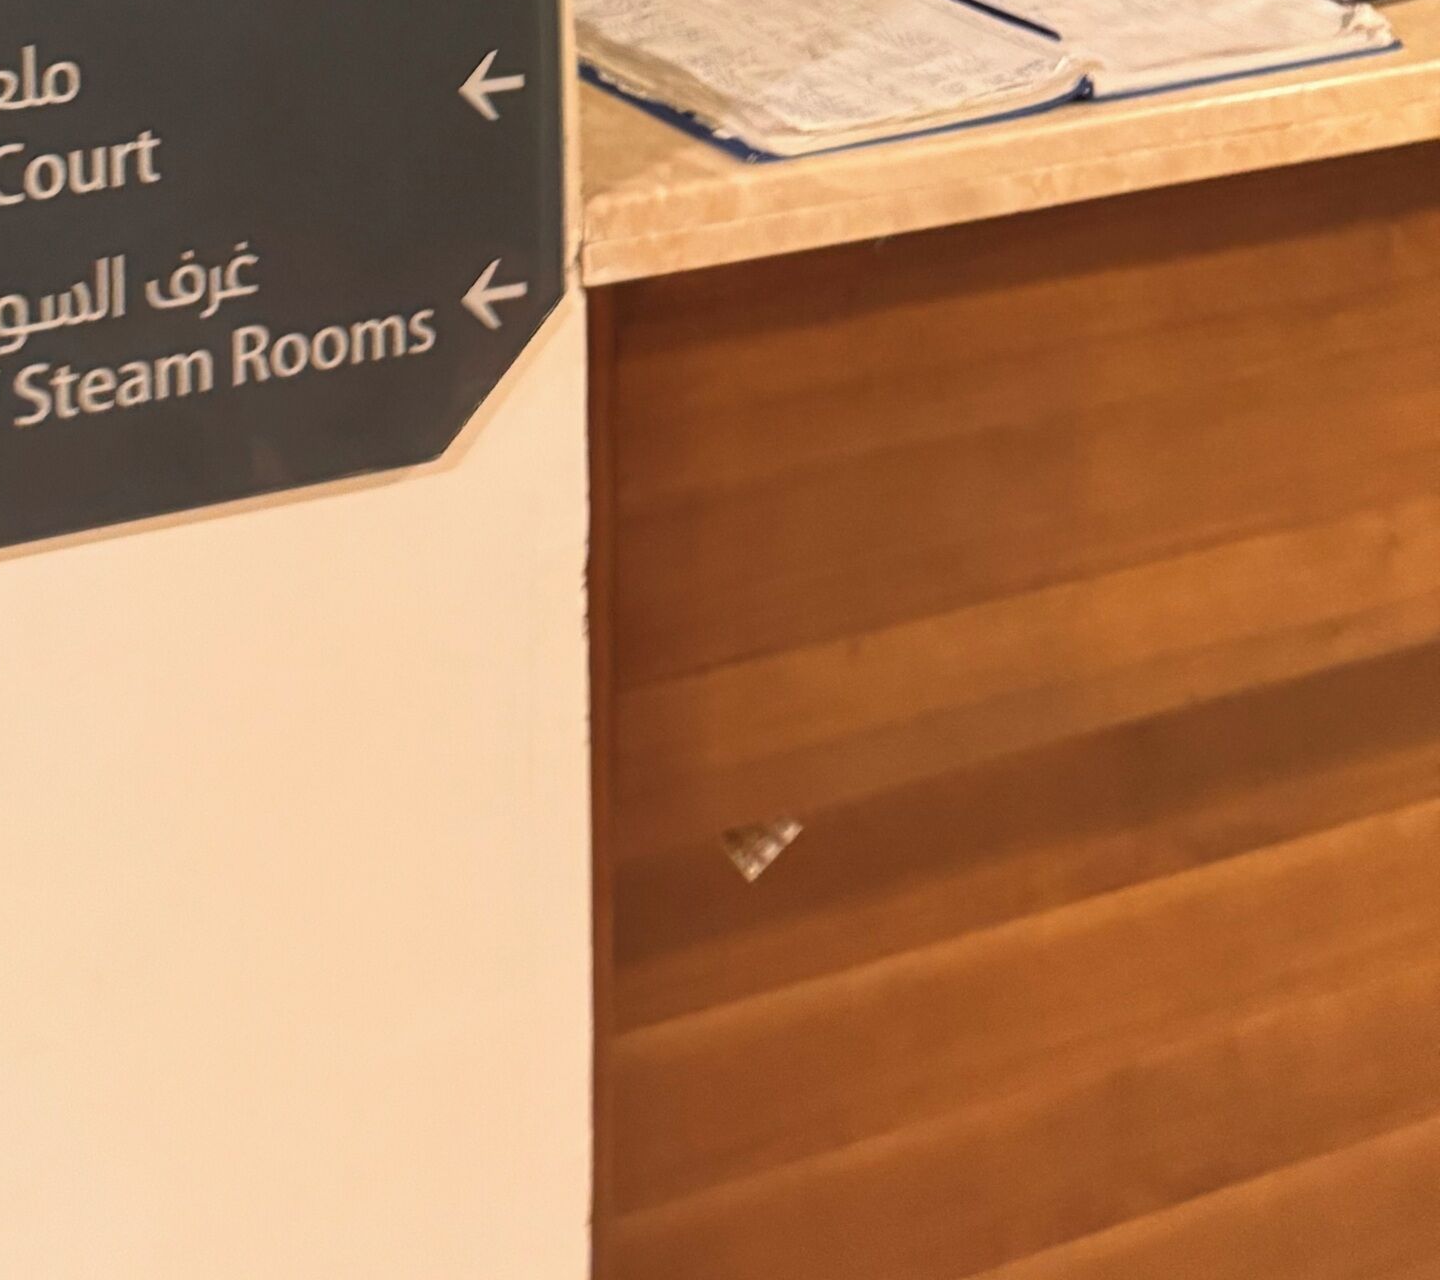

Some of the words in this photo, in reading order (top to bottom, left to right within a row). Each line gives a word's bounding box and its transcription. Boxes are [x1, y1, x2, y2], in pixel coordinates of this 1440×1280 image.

[144, 241, 260, 319] غرف
[13, 348, 214, 428] Steam
[232, 308, 437, 388] Rooms
